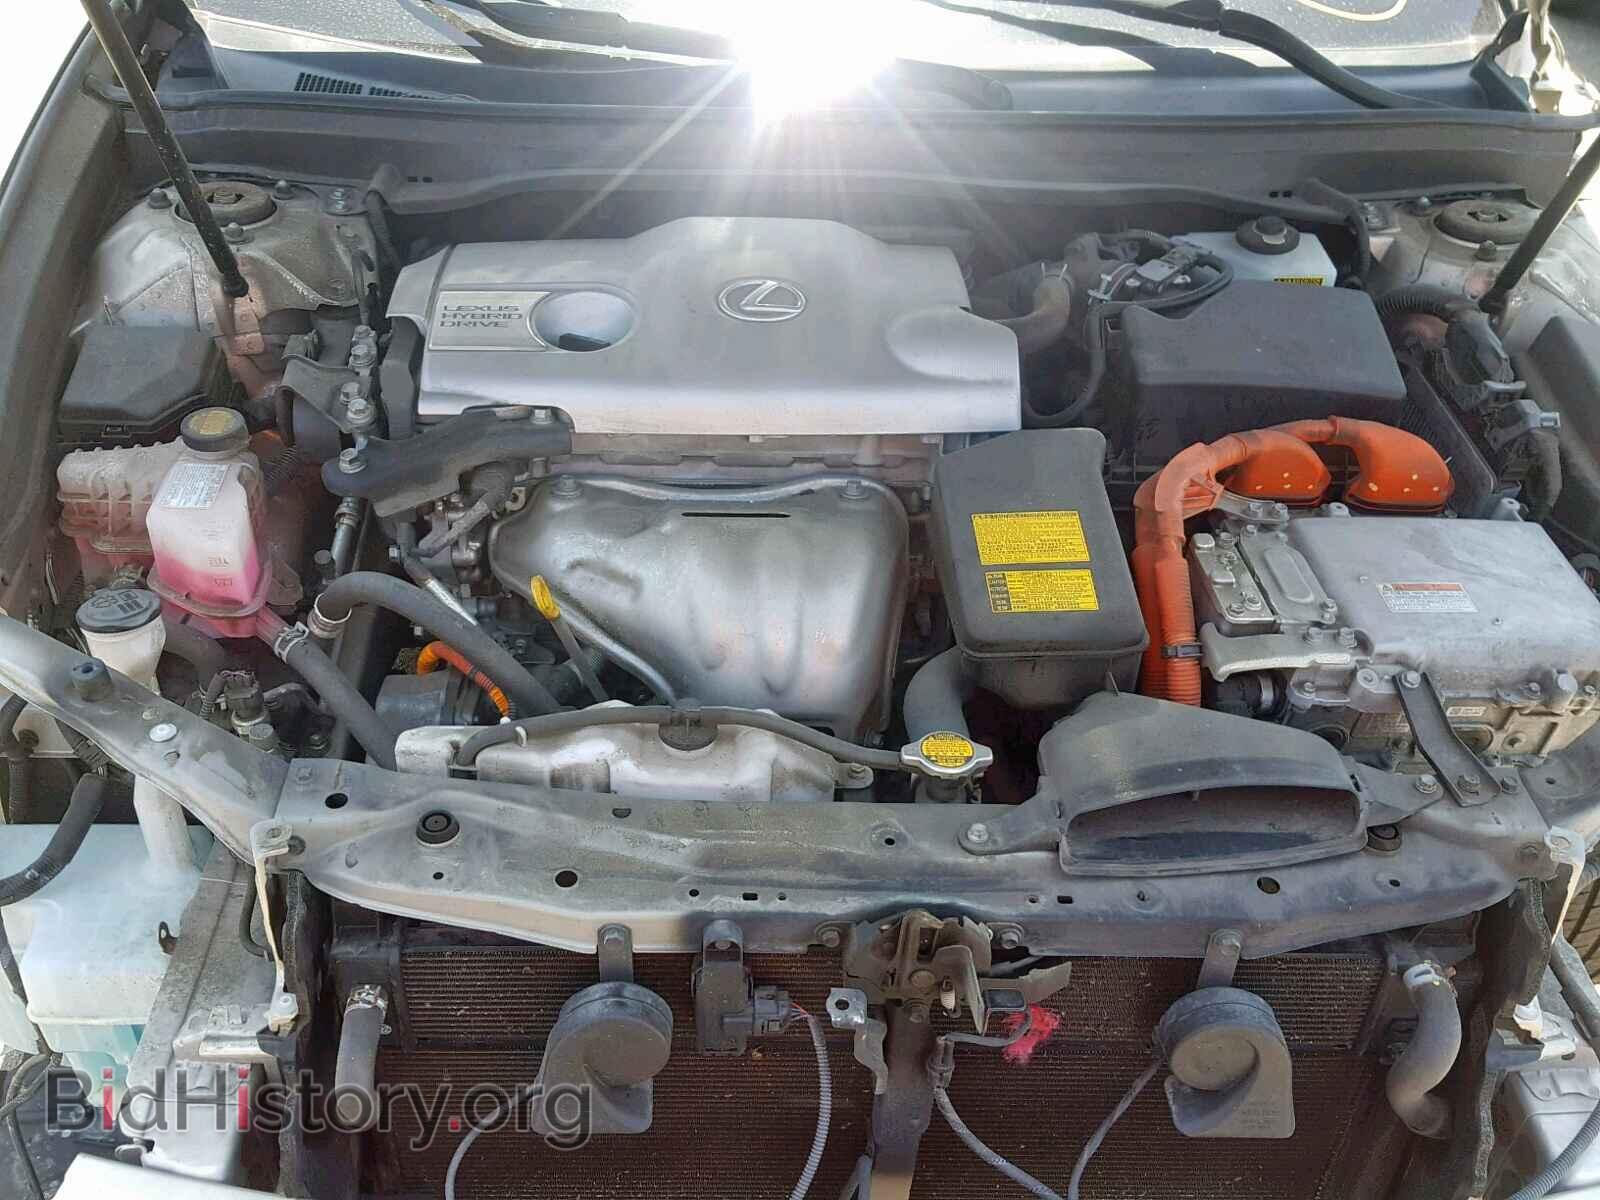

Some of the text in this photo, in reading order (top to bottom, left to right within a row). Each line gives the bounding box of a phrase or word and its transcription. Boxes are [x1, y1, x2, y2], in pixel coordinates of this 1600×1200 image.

[442, 304, 520, 312] LEXUS
[441, 312, 522, 320] HYBRID
[440, 320, 507, 328] DRIVE
